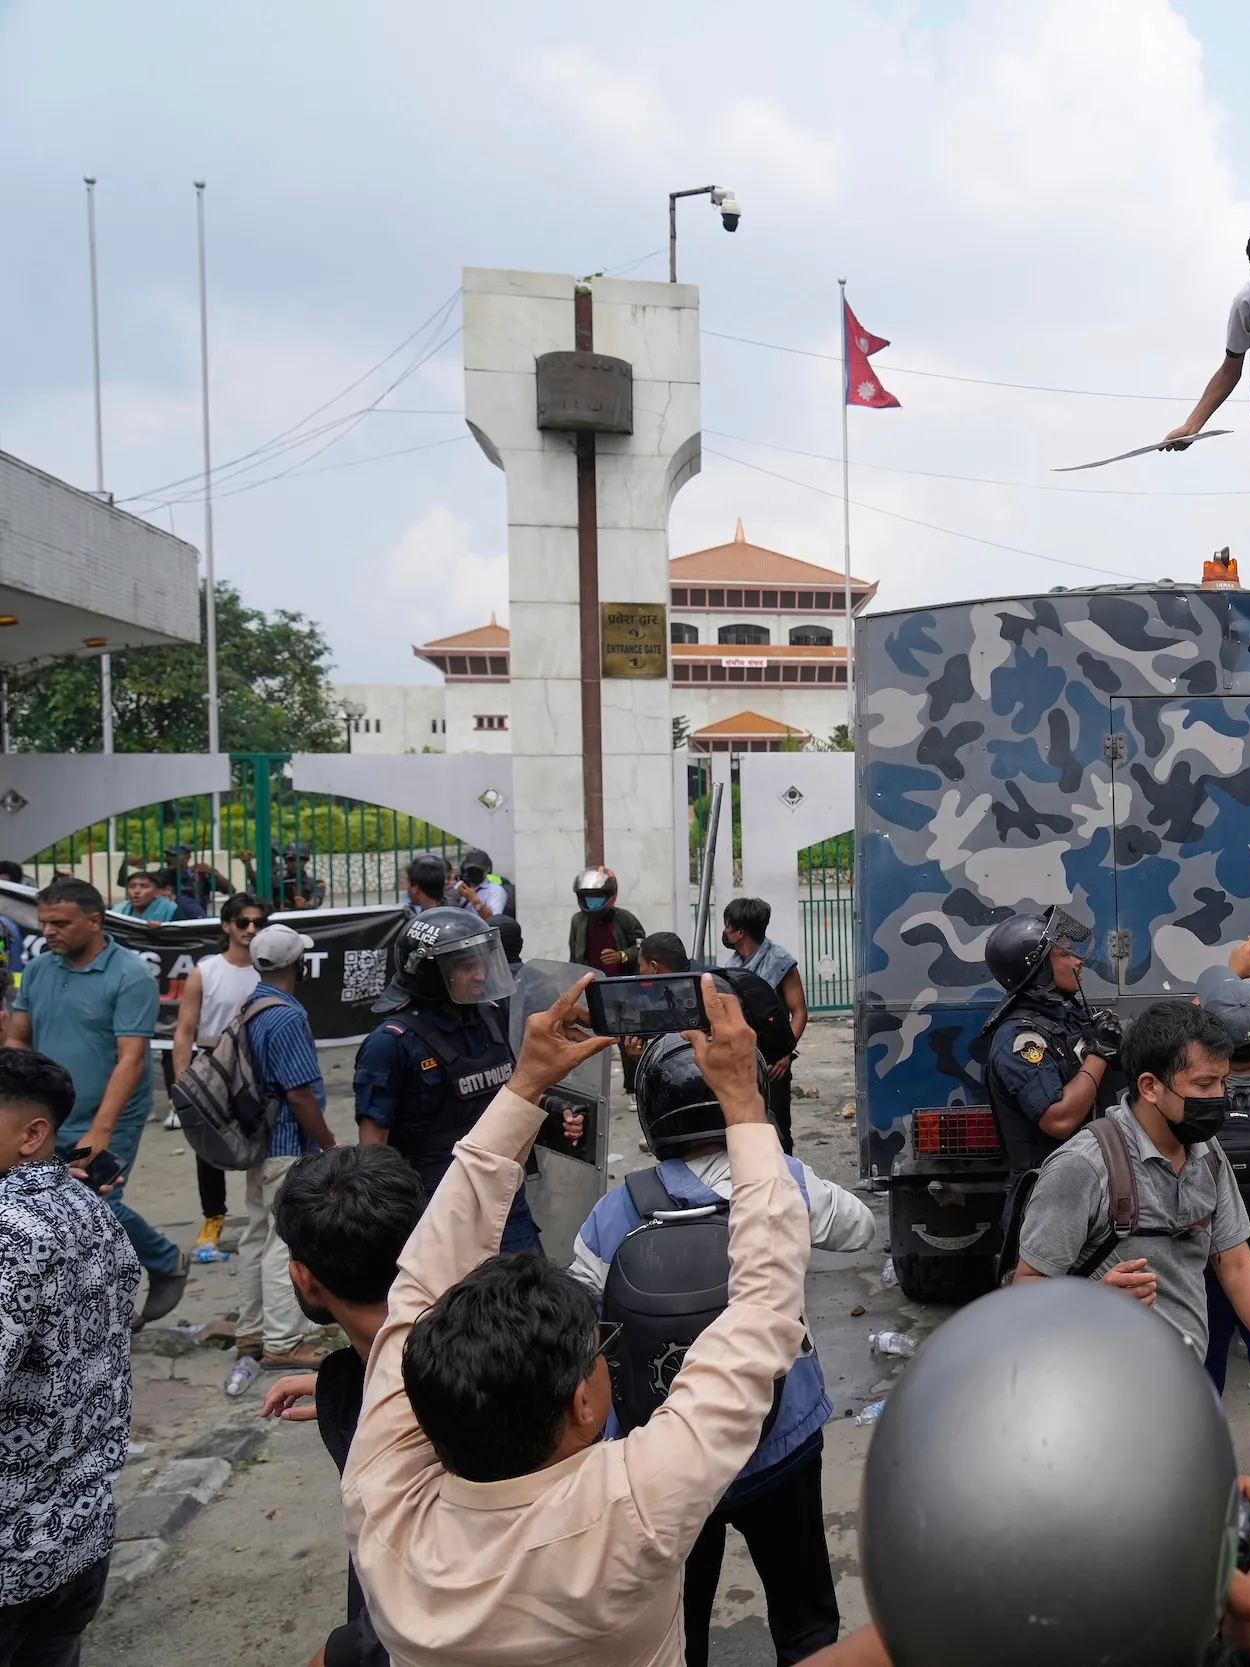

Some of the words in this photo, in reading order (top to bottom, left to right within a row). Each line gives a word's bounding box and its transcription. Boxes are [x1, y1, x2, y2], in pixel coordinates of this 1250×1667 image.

[608, 611, 634, 625] प्रवेश
[639, 614, 659, 627] द्वार
[606, 644, 642, 654] ENTRANCE
[644, 644, 662, 654] GATE
[406, 928, 437, 946] POLICE
[411, 920, 441, 937] NEPAL
[458, 1071, 486, 1096] CITY
[485, 1062, 513, 1089] POLICE
